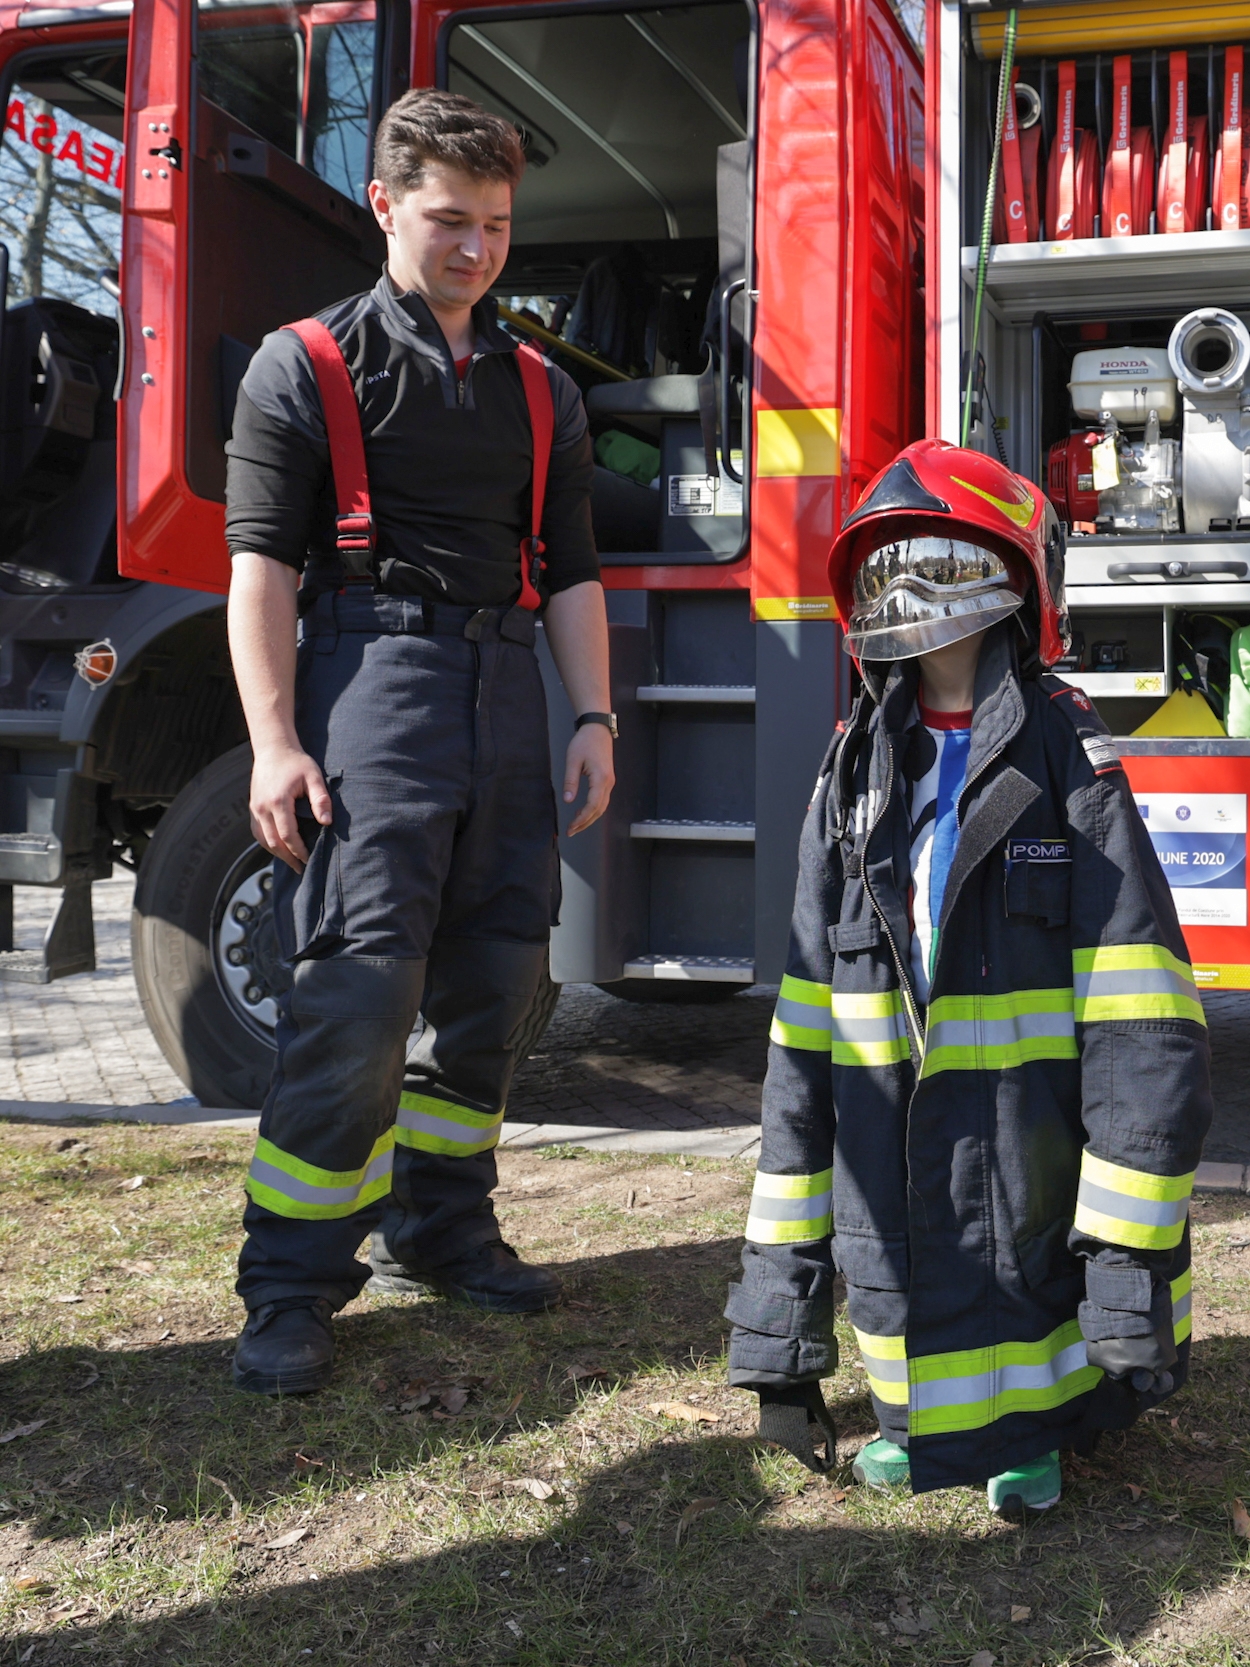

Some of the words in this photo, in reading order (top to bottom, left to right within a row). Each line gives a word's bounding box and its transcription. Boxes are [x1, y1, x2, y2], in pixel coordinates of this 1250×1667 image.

[1009, 200, 1022, 219] C
[1169, 202, 1182, 218] C
[1224, 203, 1237, 223] C
[1057, 213, 1071, 231] C
[1116, 213, 1130, 232] C
[1100, 360, 1148, 368] HONDA
[1192, 851, 1225, 866] 2020
